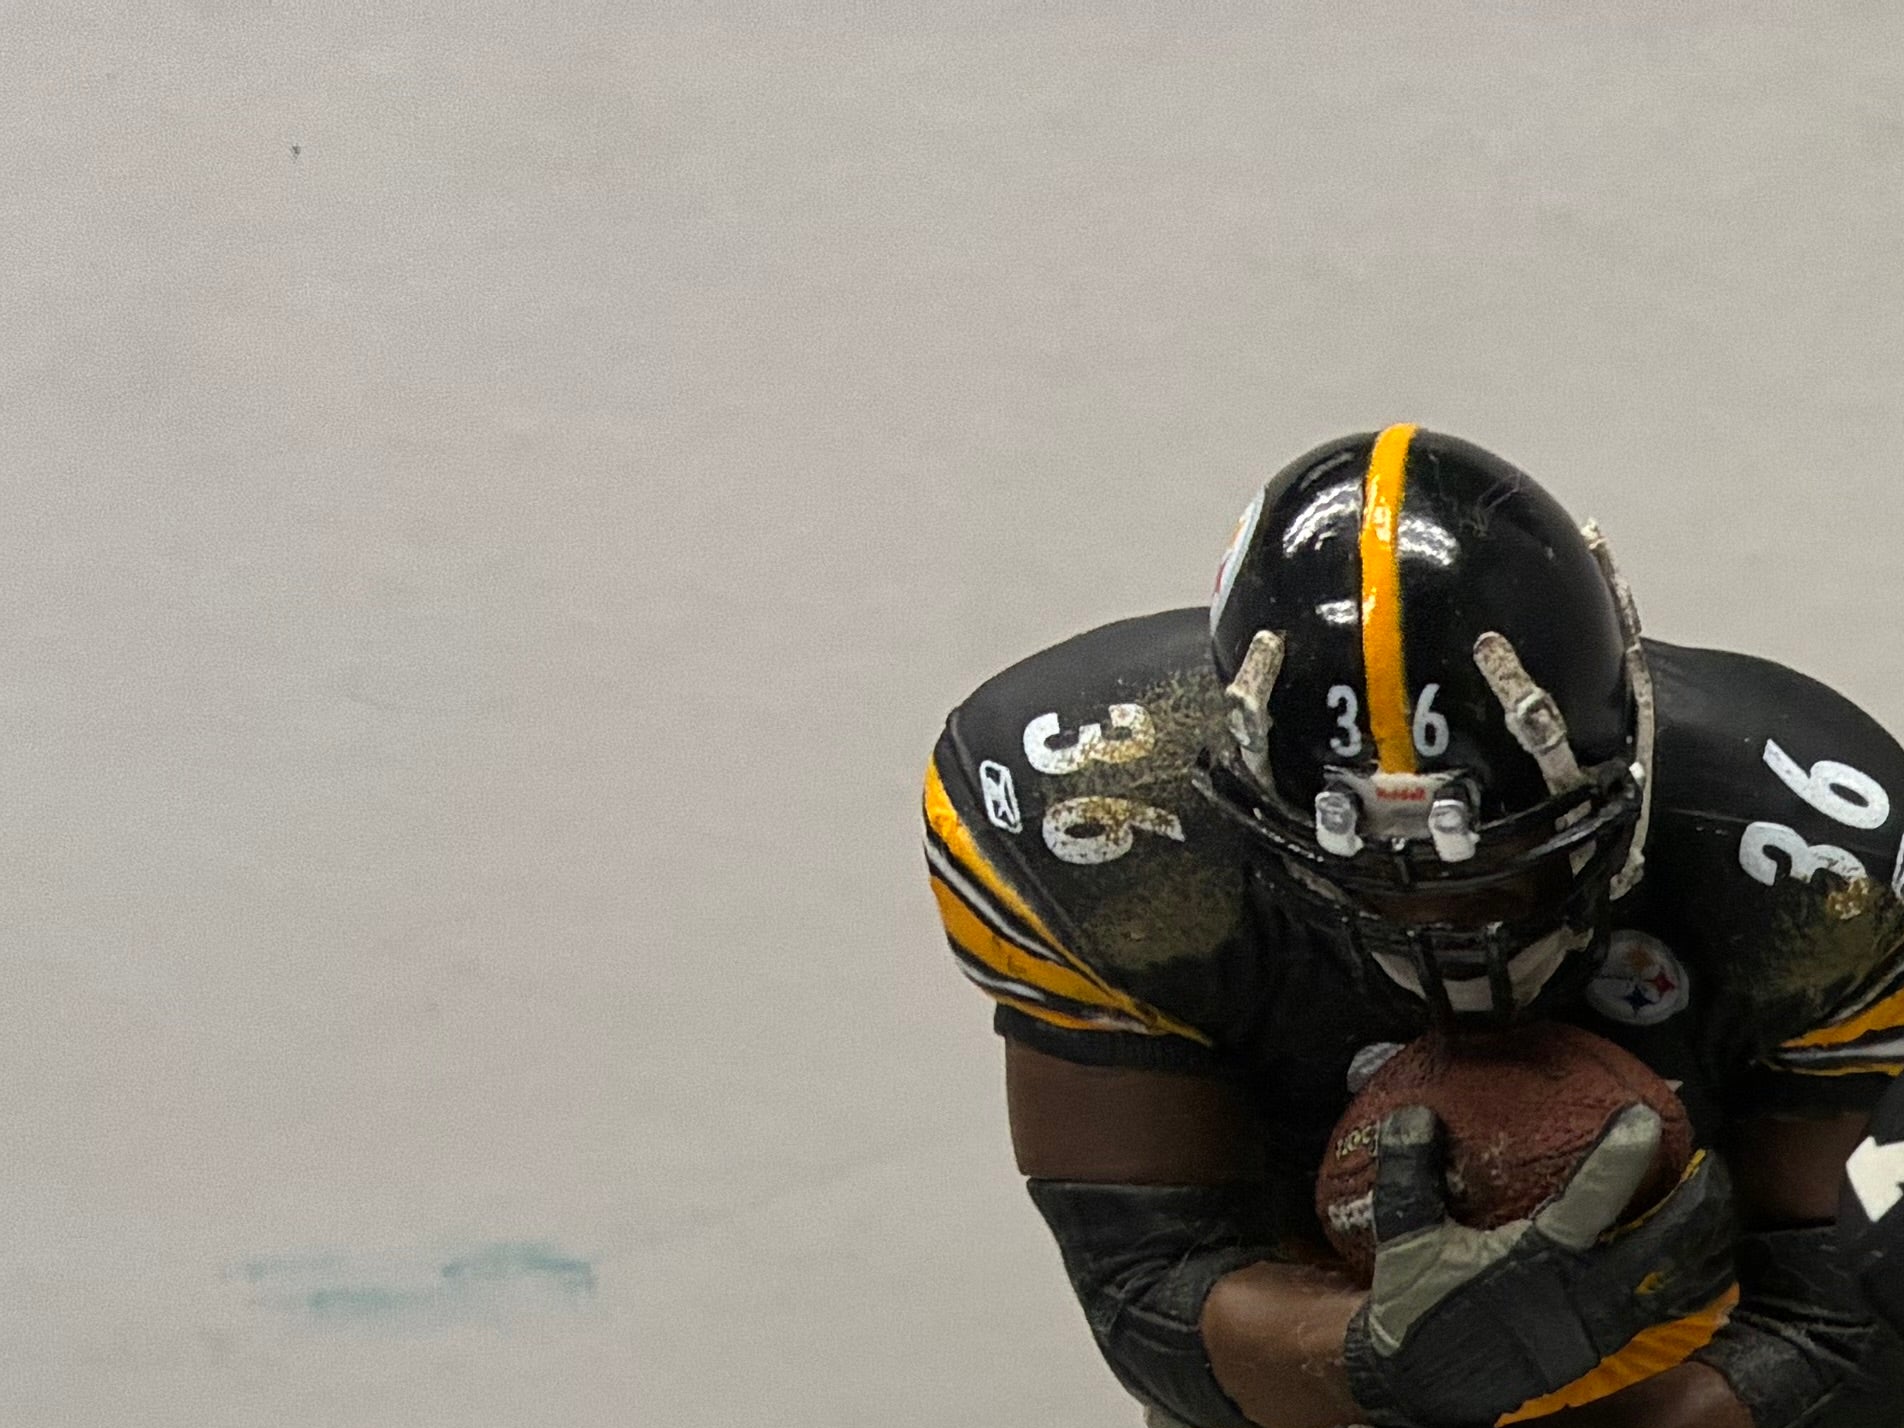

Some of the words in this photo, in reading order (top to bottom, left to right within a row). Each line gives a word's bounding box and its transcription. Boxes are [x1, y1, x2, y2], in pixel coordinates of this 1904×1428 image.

[1023, 703, 1186, 865] 36
[1327, 683, 1449, 757] 36
[1738, 739, 1889, 919] 36
